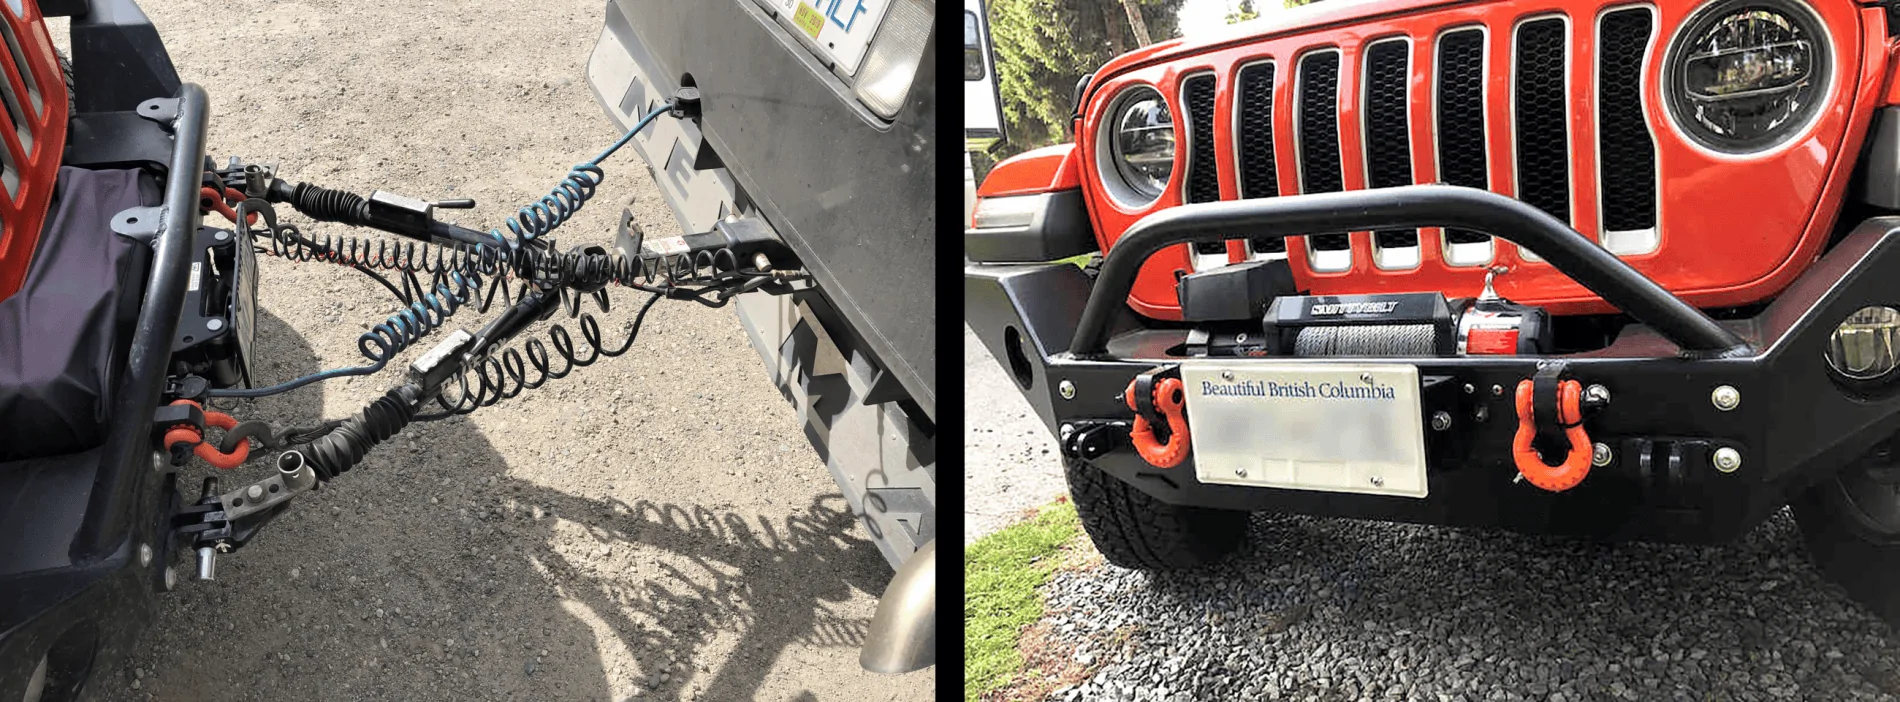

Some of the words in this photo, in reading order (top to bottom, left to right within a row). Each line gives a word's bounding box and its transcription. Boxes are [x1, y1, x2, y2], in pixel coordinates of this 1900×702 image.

[815, 0, 869, 33] LF
[1202, 381, 1265, 397] Beautiful
[1268, 381, 1316, 398] British
[1319, 380, 1396, 400] Columbia
